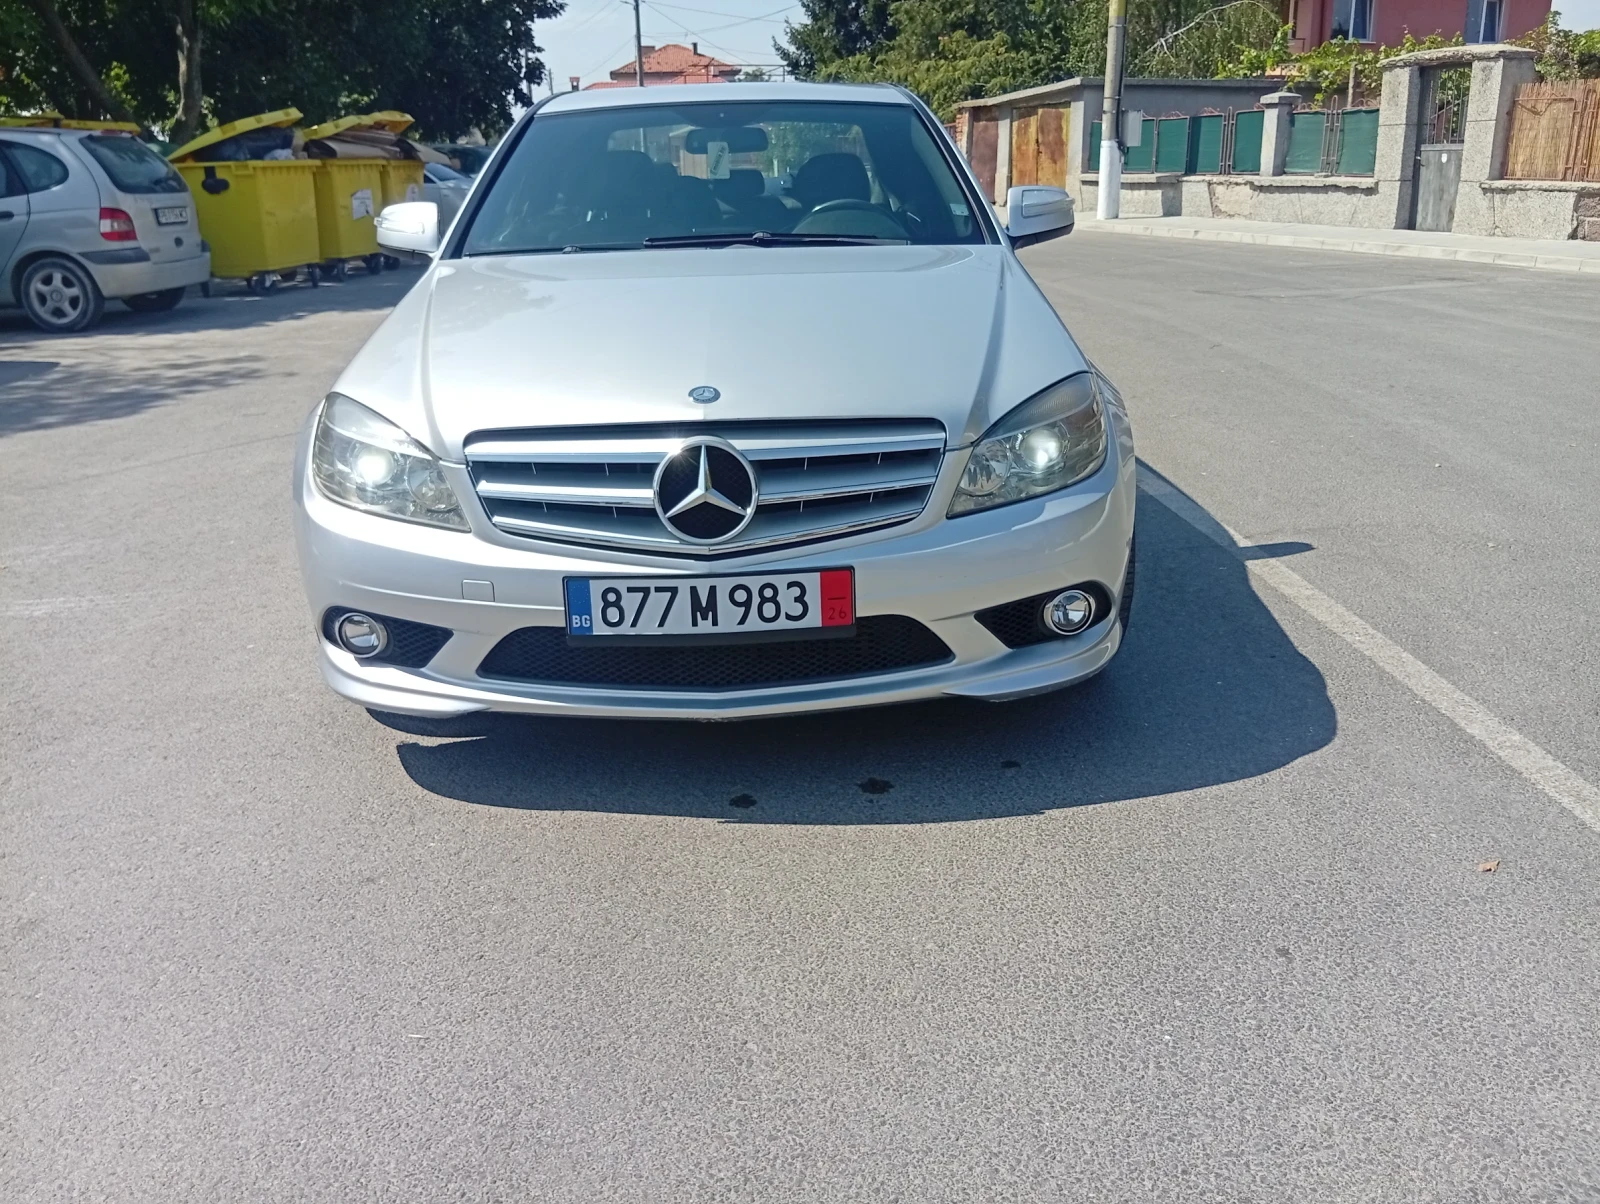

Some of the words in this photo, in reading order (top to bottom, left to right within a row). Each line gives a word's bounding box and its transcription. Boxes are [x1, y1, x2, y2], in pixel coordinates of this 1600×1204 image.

[600, 586, 679, 628] 877
[689, 585, 719, 627] M
[728, 581, 809, 626] 983
[827, 606, 847, 620] 26
[572, 614, 591, 628] BG
